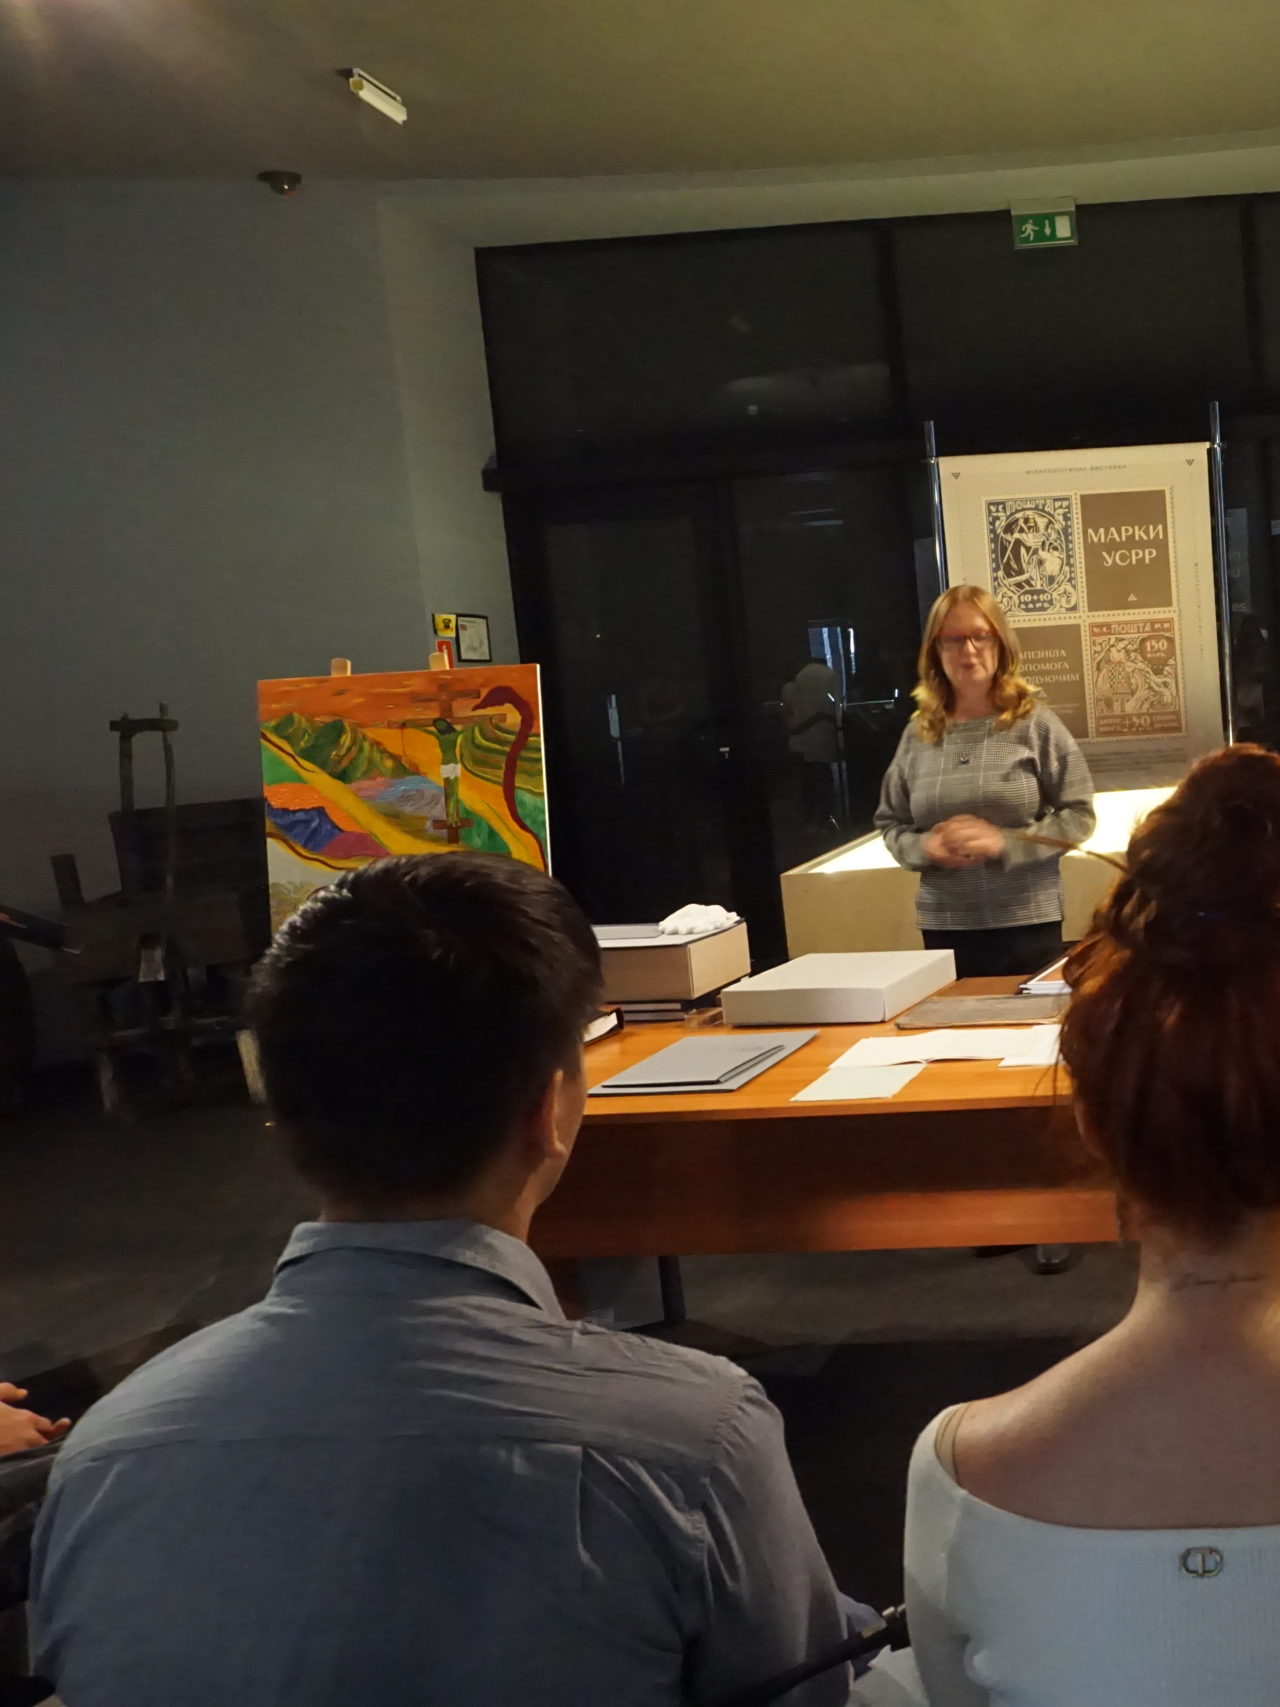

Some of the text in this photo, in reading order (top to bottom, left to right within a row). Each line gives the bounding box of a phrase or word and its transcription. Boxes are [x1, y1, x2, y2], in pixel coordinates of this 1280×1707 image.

[1006, 499, 1054, 514] ПОШТА
[1087, 524, 1164, 544] МАРКИ
[1102, 548, 1157, 567] УСРР
[1111, 622, 1152, 634] ПОШТА
[1146, 639, 1168, 652] 150
[1019, 648, 1067, 660] АПІЗНІЛА
[1019, 661, 1070, 673] ОПОМОГА
